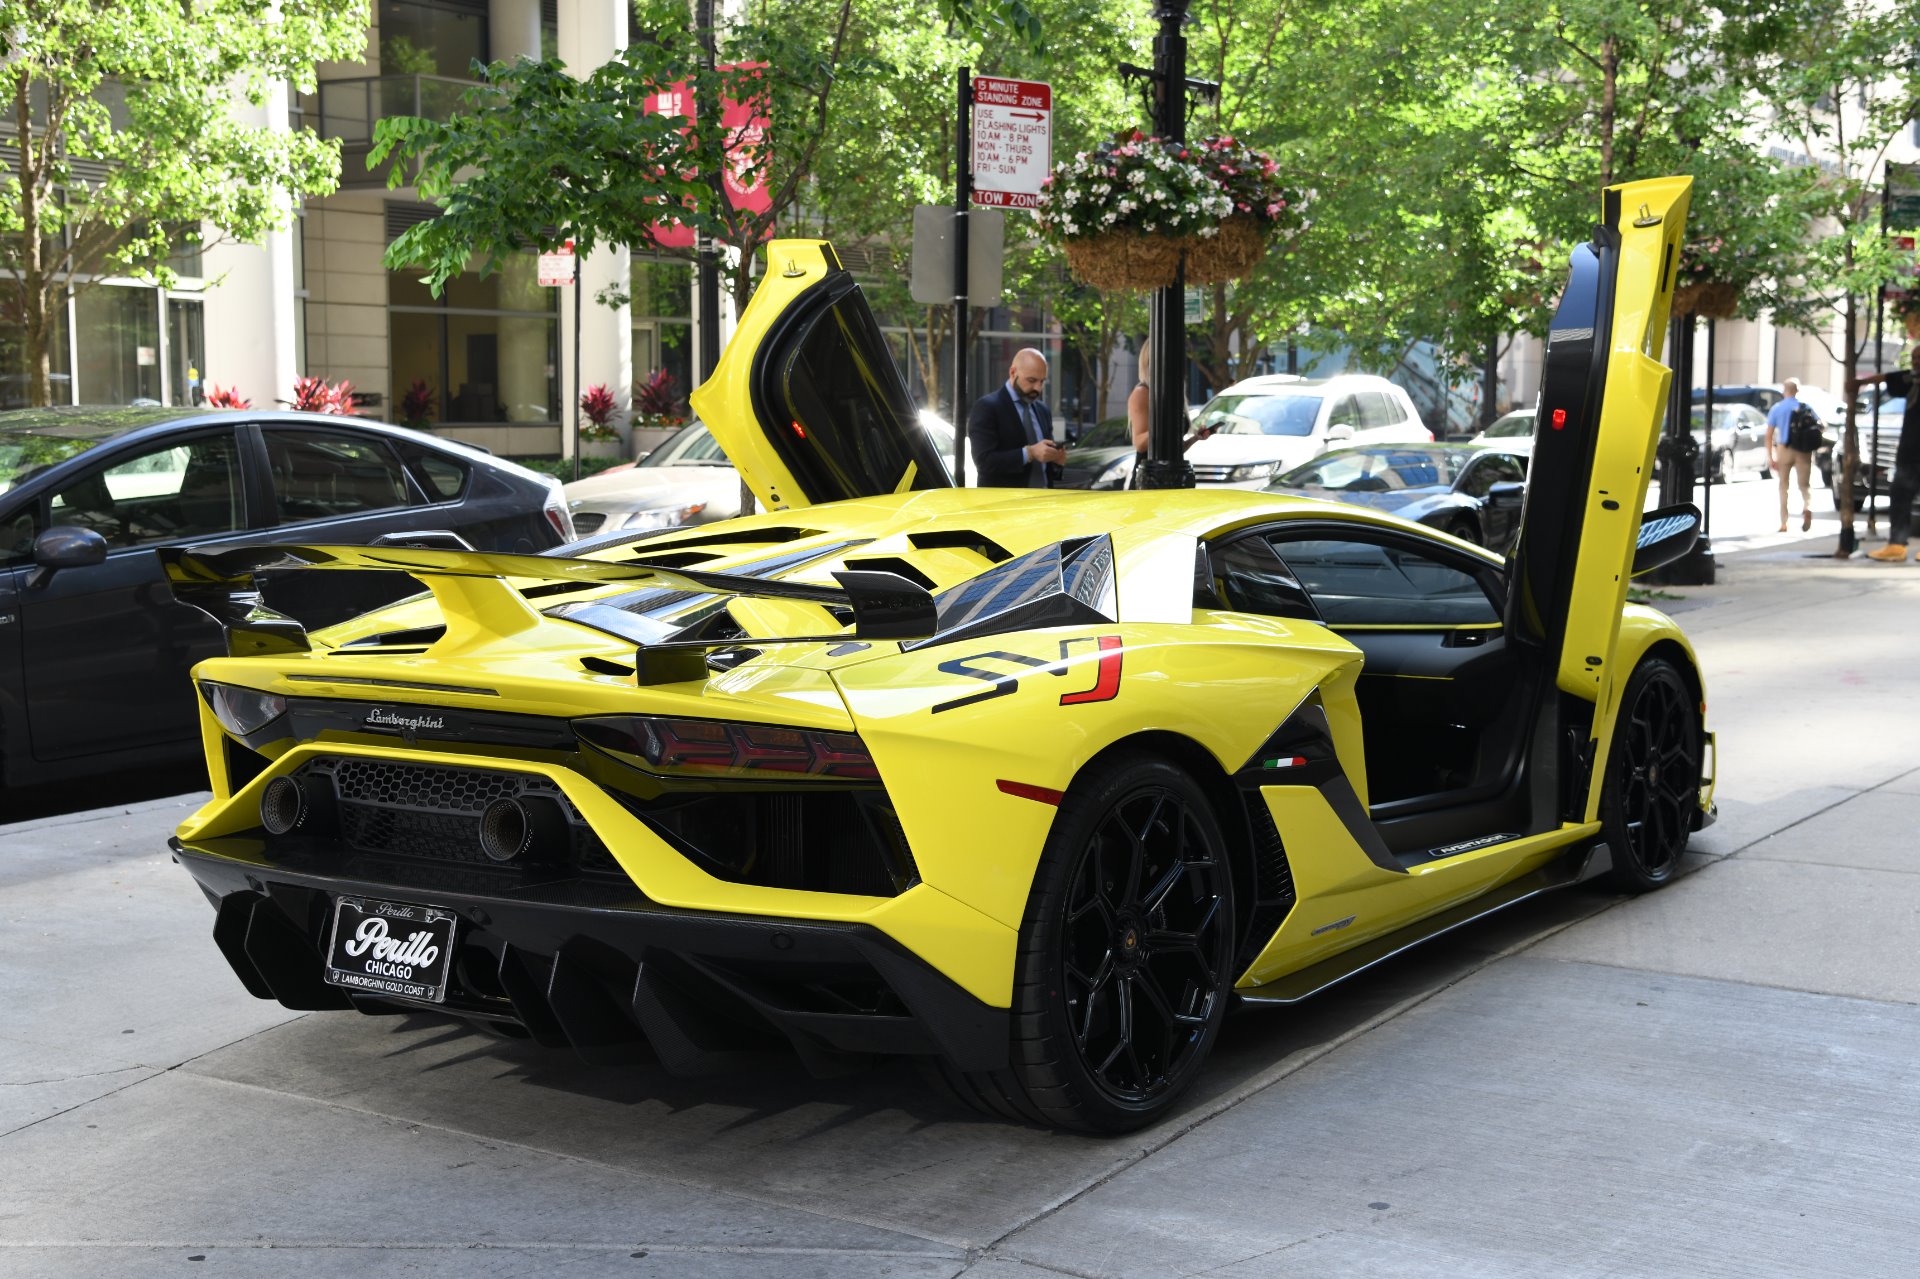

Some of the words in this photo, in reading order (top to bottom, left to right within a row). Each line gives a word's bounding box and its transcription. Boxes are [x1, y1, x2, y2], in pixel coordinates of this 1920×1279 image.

[978, 80, 987, 91] 15
[988, 82, 1019, 94] MINUTE
[978, 92, 1017, 105] STANDING
[1021, 96, 1043, 107] ZONE
[977, 109, 994, 119] USE
[977, 120, 1017, 132] FLASHING
[1019, 124, 1047, 135] LIGHTS
[1009, 133, 1015, 142] 8
[1017, 134, 1029, 142] PM
[977, 141, 996, 151] MON
[1006, 144, 1033, 155] THURS
[1009, 155, 1014, 163] 6
[1016, 156, 1028, 165] PM
[977, 163, 991, 172] FRI
[999, 165, 1017, 174] SUN
[977, 191, 1004, 205] TOW
[366, 708, 444, 730] Lamborghini
[376, 903, 414, 918] Perillo
[345, 917, 439, 969] Perillo
[365, 960, 412, 979] CHICAGO
[341, 974, 385, 989] LAMBORGHINI
[385, 981, 403, 993] GOLD
[404, 985, 425, 996] COAST
